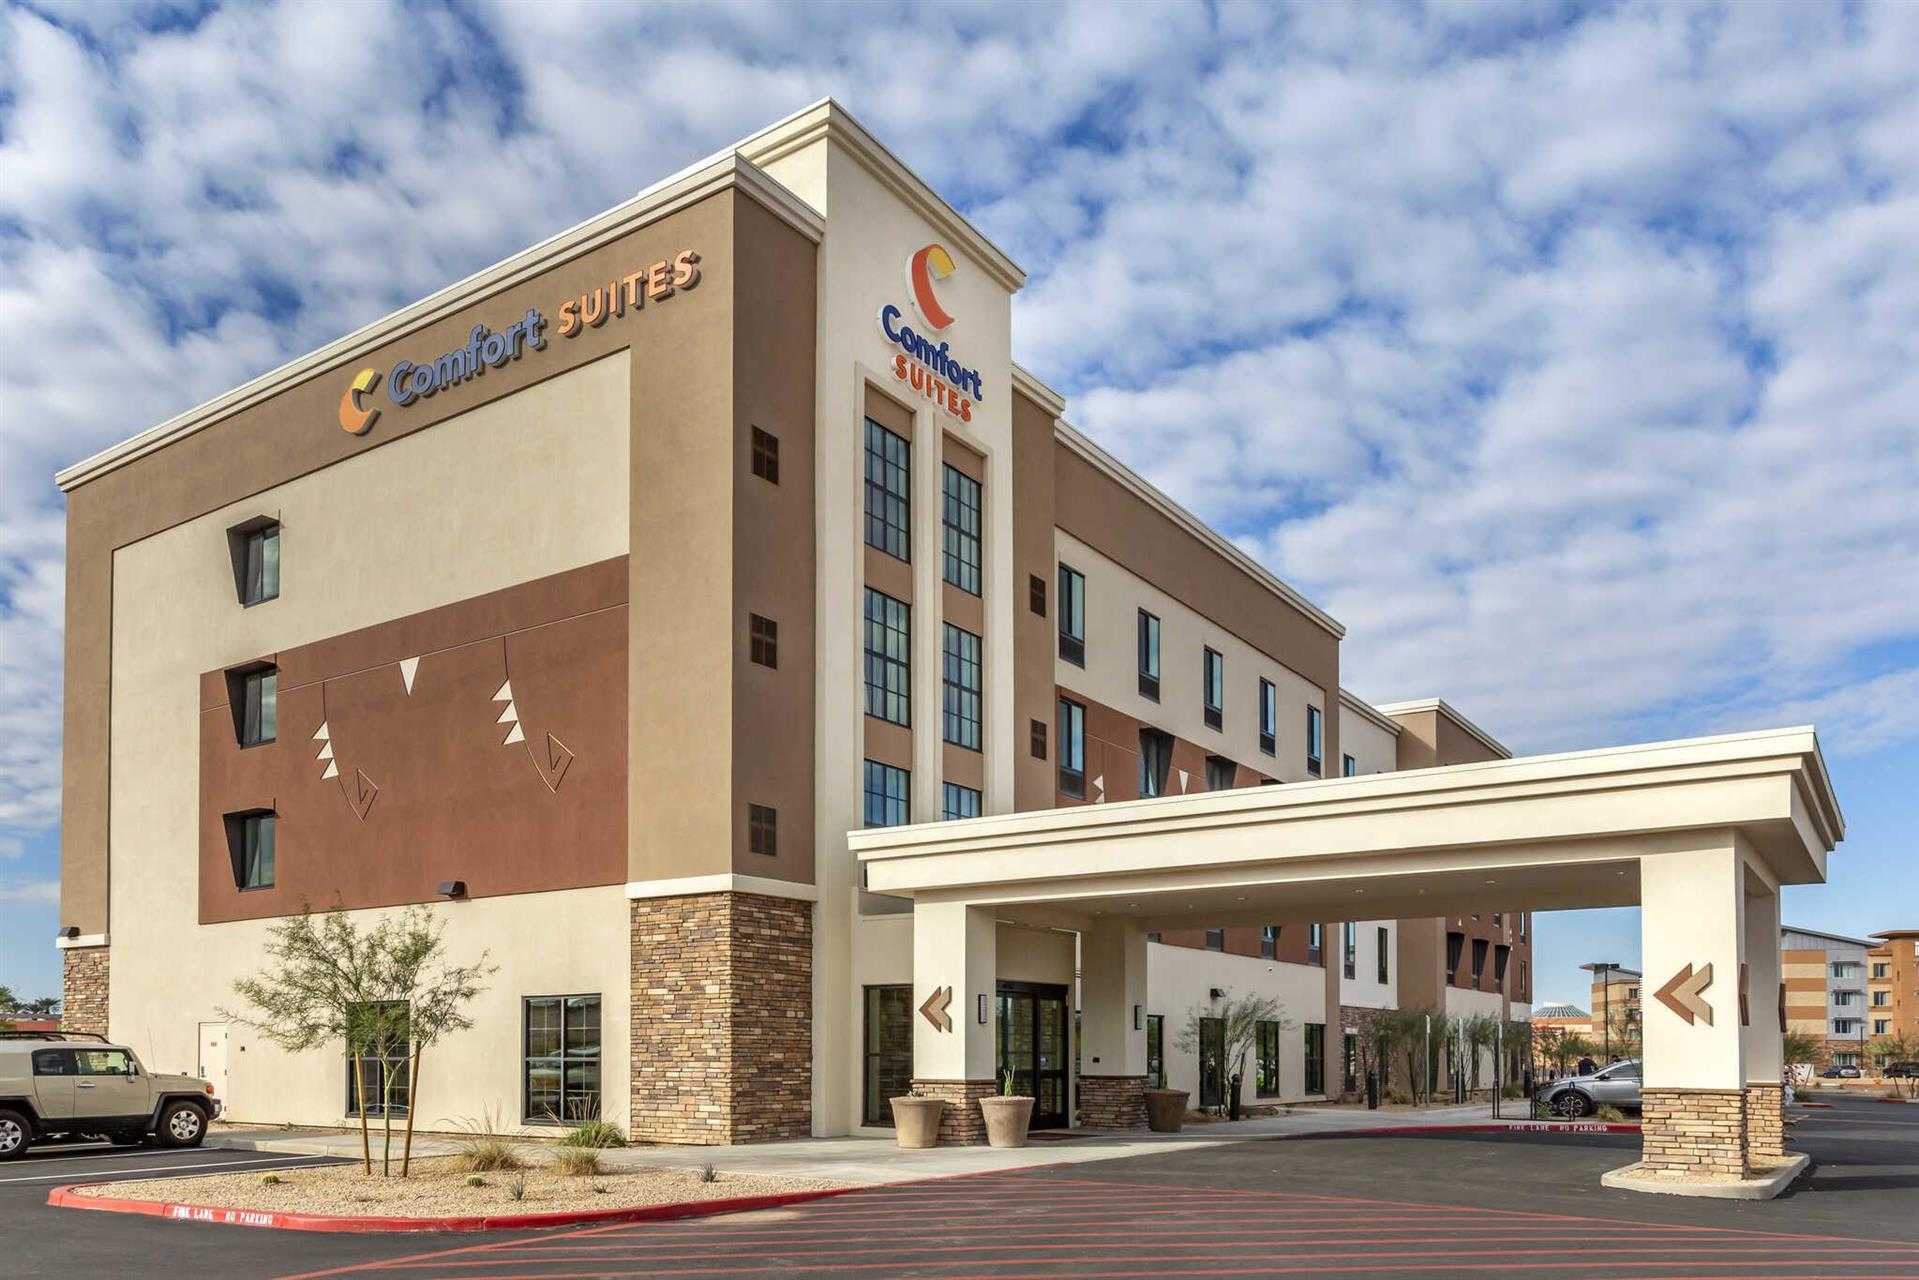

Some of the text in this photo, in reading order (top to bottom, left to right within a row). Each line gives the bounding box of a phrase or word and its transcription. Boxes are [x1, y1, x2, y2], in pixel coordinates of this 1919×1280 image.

[387, 308, 548, 407] Comfort
[557, 248, 703, 338] SUITES
[880, 304, 984, 402] Comfort
[893, 353, 973, 423] SUITES
[1573, 1124, 1608, 1132] PARKING
[239, 1211, 273, 1226] PARKING
